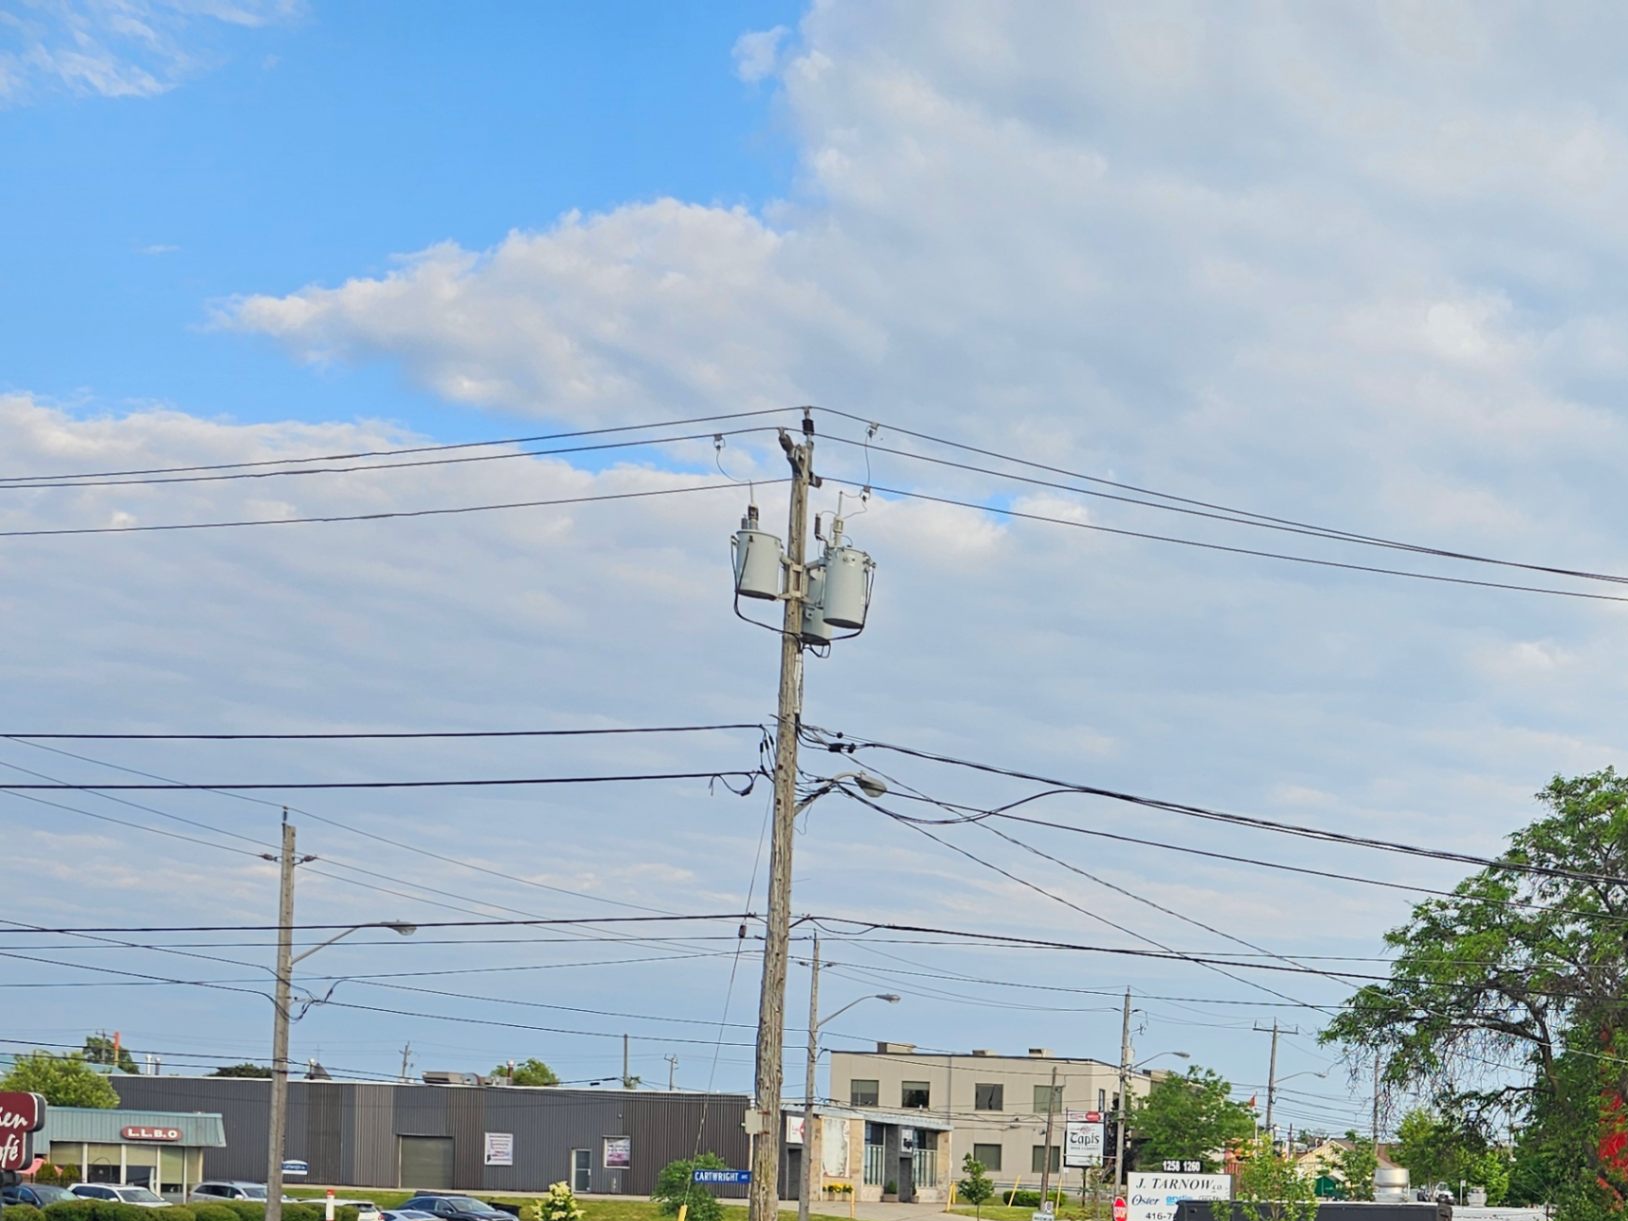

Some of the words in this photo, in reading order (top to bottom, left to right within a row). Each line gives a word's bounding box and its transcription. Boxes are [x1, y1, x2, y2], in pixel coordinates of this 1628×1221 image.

[1070, 1131, 1100, 1147] Tapis
[1162, 1160, 1181, 1172] 1258
[1183, 1160, 1201, 1172] 1260
[694, 1171, 739, 1182] CARTWRIGHT
[1135, 1177, 1147, 1190] J.
[1152, 1178, 1215, 1191] TARNOW
[1131, 1194, 1160, 1206] Oster
